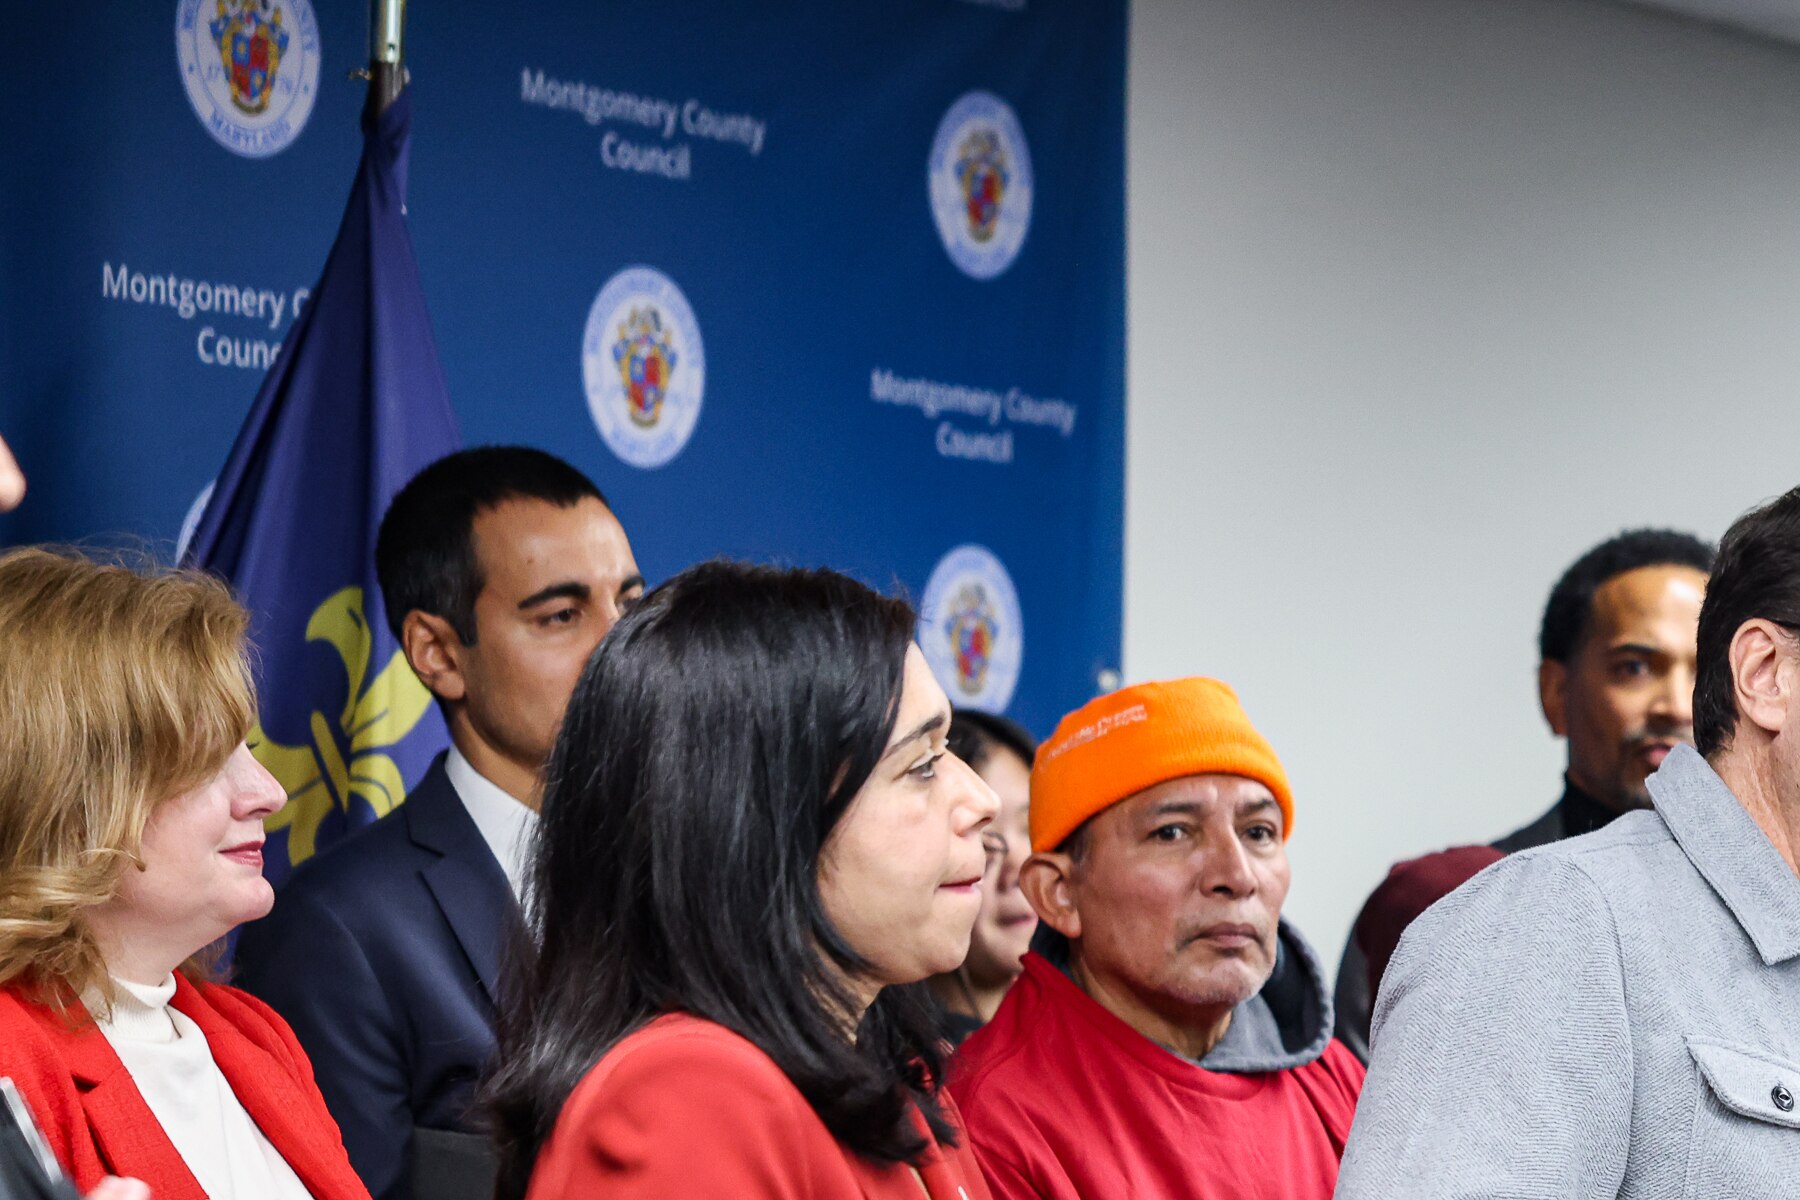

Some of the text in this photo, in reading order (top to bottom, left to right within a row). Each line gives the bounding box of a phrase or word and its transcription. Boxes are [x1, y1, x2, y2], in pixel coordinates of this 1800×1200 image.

[521, 67, 679, 139] Montgomery
[601, 131, 692, 180] Council
[103, 262, 286, 329] Montgomery
